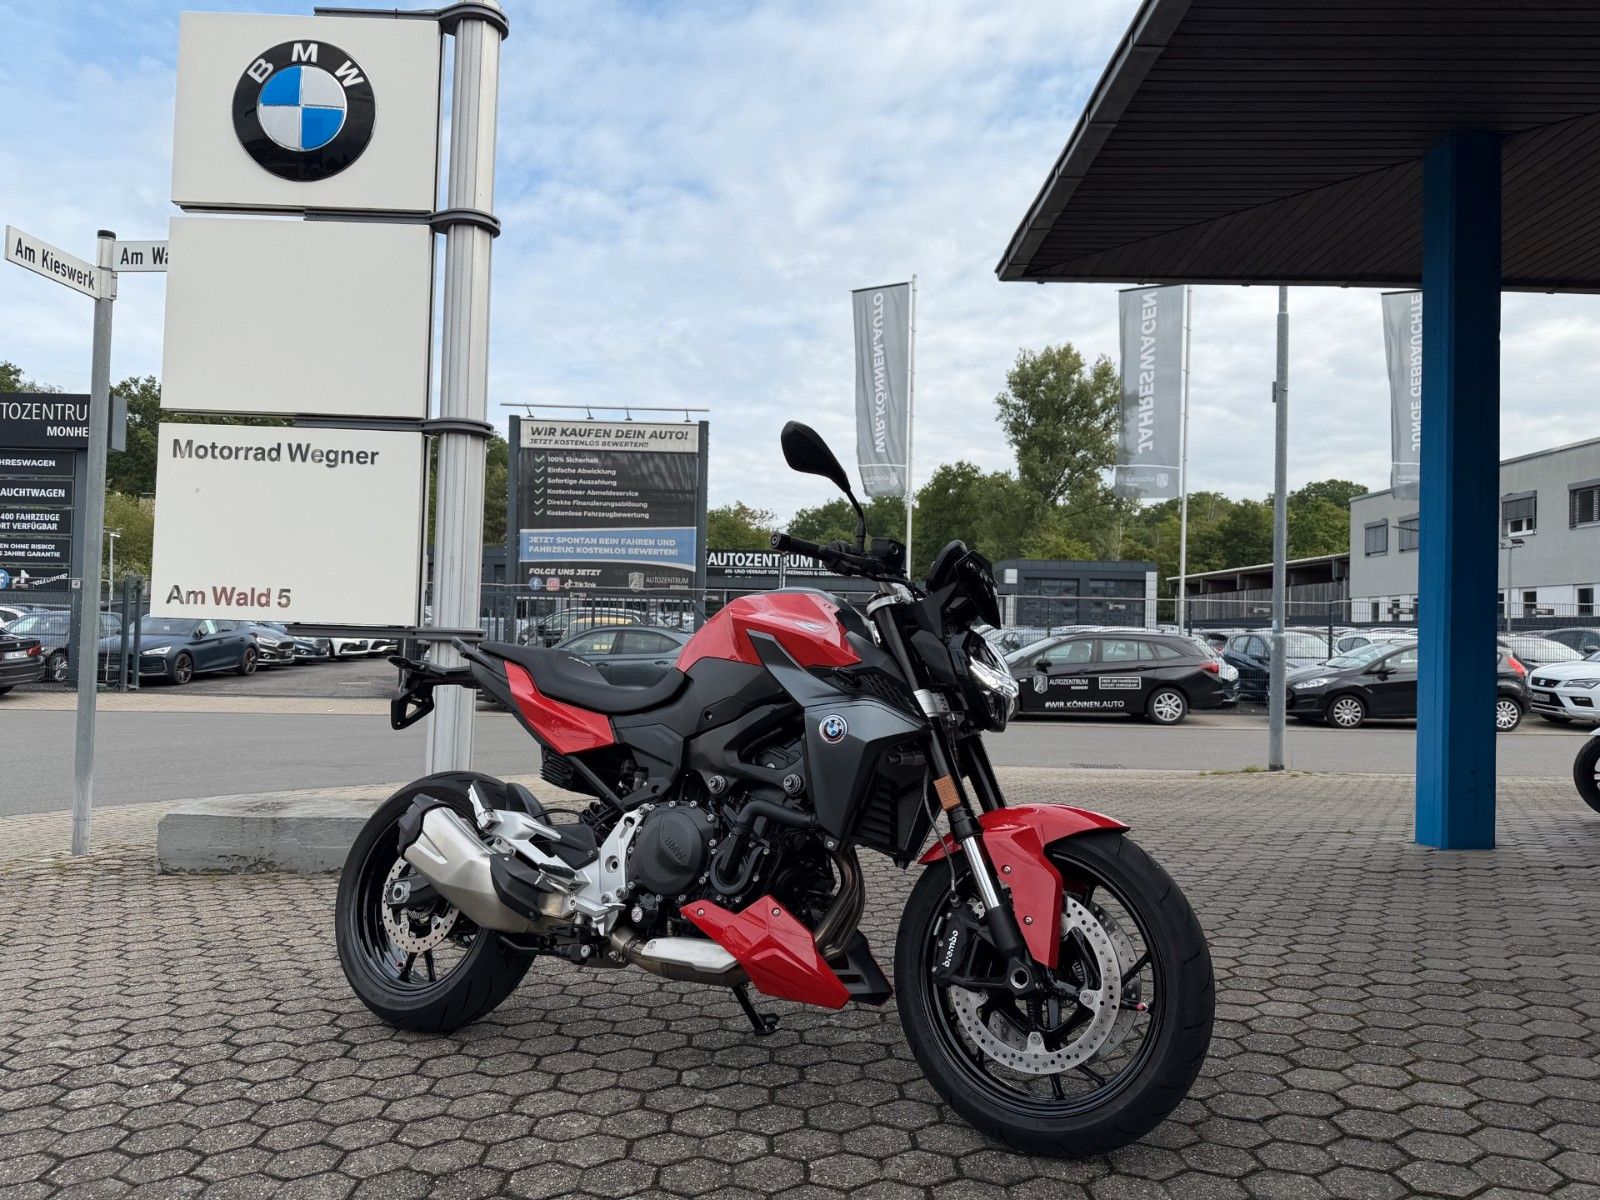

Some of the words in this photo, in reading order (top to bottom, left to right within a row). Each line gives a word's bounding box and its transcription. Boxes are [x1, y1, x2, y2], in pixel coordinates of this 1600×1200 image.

[247, 43, 364, 87] BMW
[120, 247, 143, 265] Am
[15, 237, 35, 264] Am
[42, 248, 95, 290] Kieswerk
[0, 402, 87, 421] TOZENTRU
[46, 426, 89, 437] MONHE
[530, 426, 557, 437] WIR
[559, 427, 612, 438] KAUFEN
[614, 429, 646, 439] DEIN
[649, 430, 689, 440] AUTO!
[172, 438, 282, 462] Motorrad
[287, 442, 380, 468] Wegner
[566, 456, 599, 464] Sicherheit
[547, 466, 576, 474] Einfache
[577, 467, 617, 476] Abwicklung
[547, 477, 577, 486] Sofortige
[578, 478, 617, 487] Auszahlung
[0, 488, 65, 497] AUCHTWAGEN
[586, 489, 639, 497] Abmeldeservice
[16, 513, 60, 521] FAHRZEUGE
[583, 510, 650, 519] Fahrzeugbewertung
[12, 521, 58, 530] VERFÜGBAR
[529, 536, 554, 544] JETZT
[556, 536, 597, 545] SPONTAN
[598, 537, 619, 545] REIN
[621, 538, 655, 546] FAHREN
[529, 545, 574, 553] FAHRZEUG
[576, 546, 626, 554] KOSTENLOS
[707, 552, 813, 568] AUTOZENTRUM
[557, 568, 575, 576] UNS
[645, 576, 689, 584] AUTOZENTRUM
[165, 584, 206, 605] Am
[212, 586, 271, 608] Wald
[277, 588, 291, 608] 5
[942, 930, 959, 968] brembo
